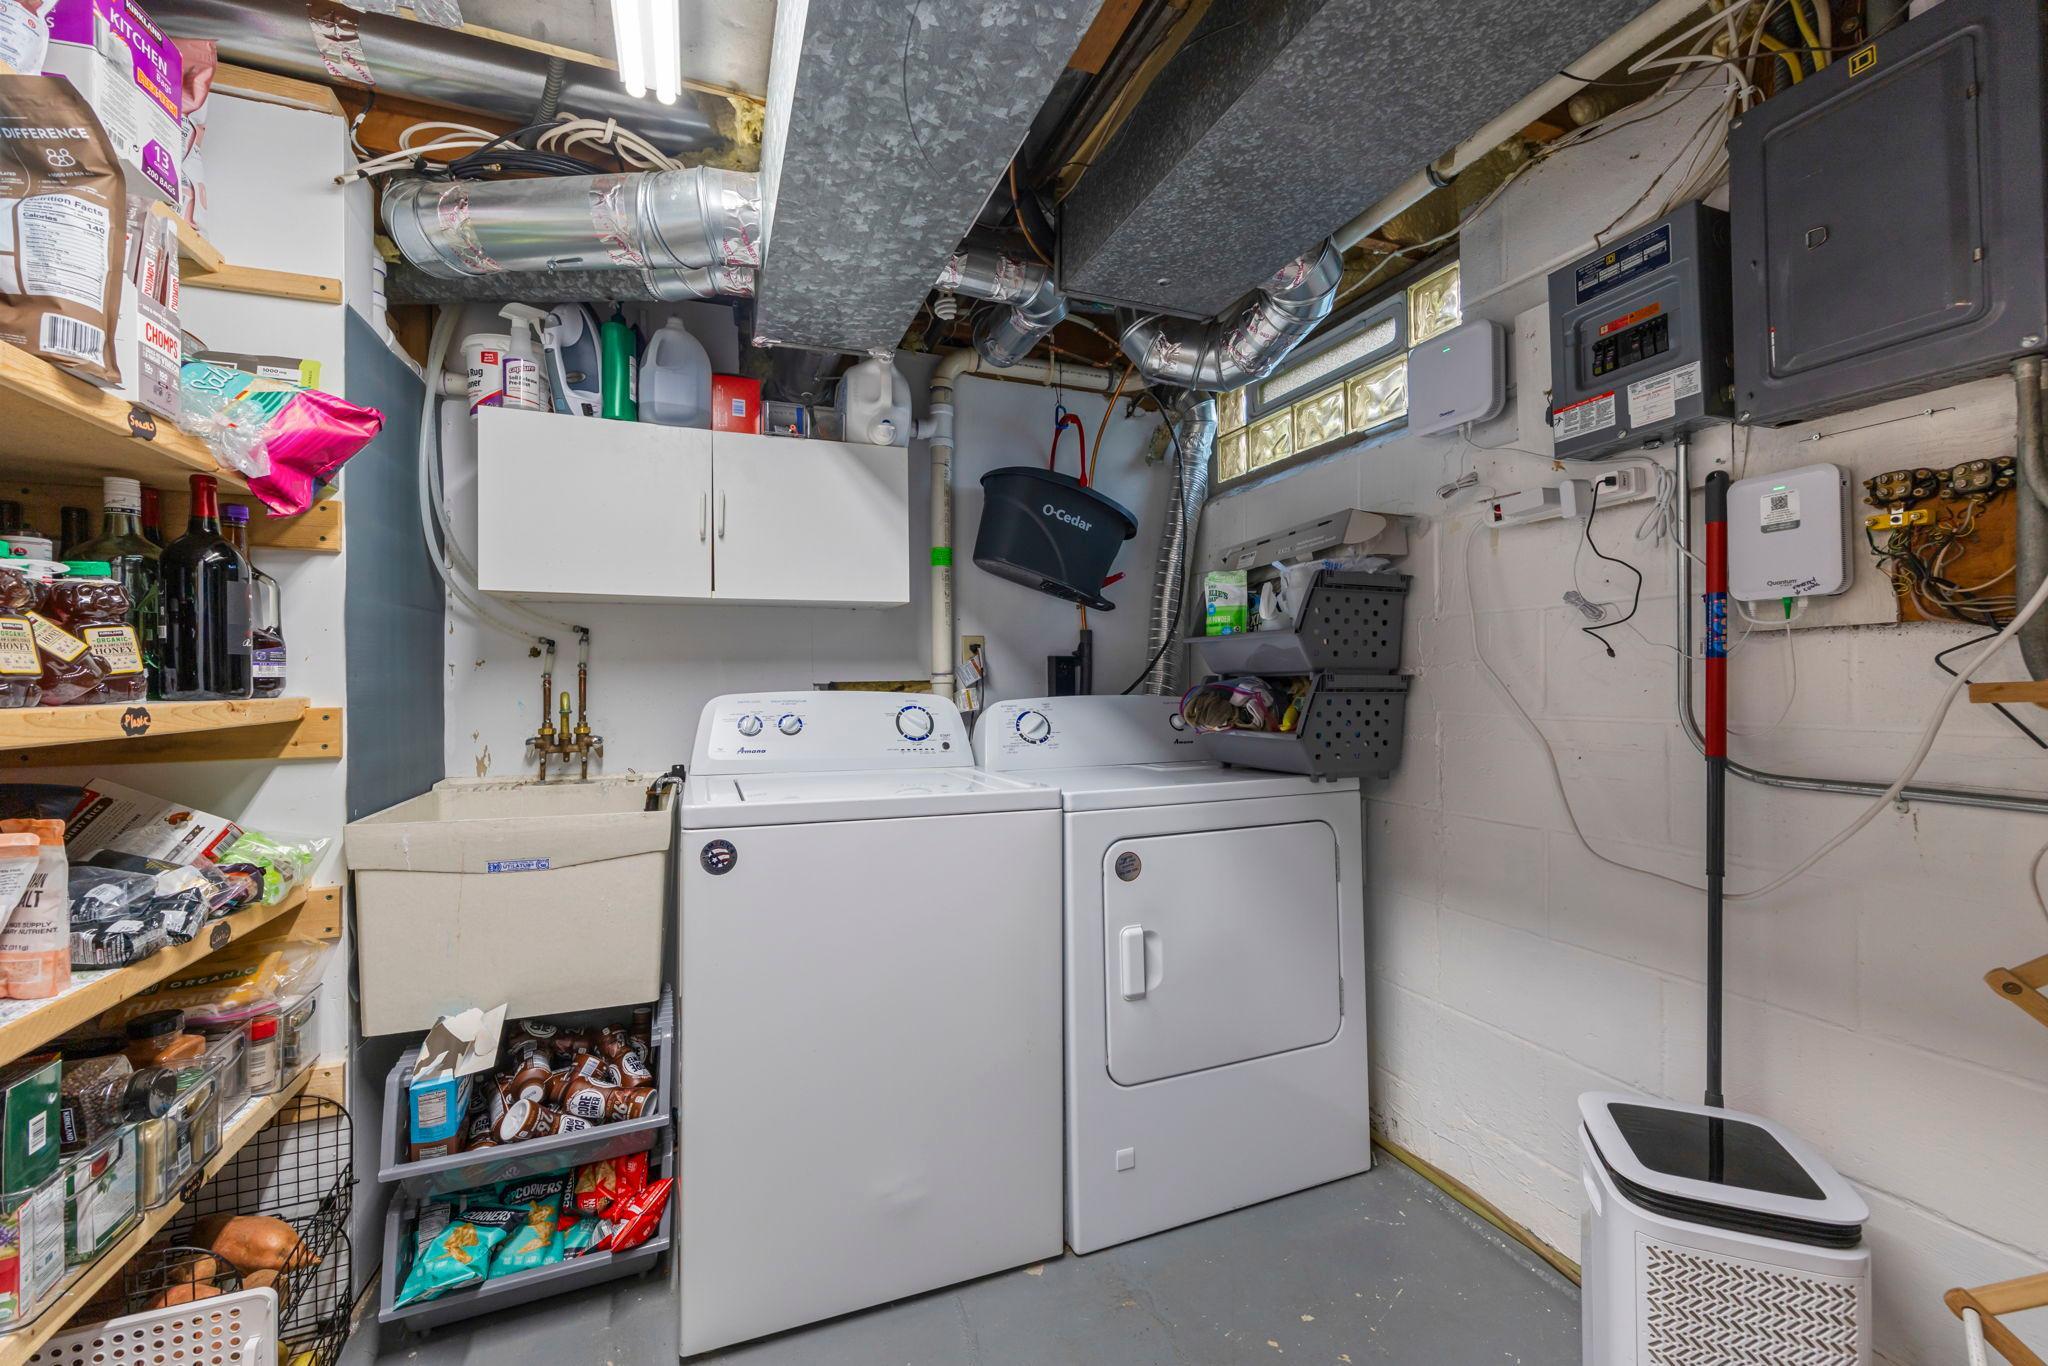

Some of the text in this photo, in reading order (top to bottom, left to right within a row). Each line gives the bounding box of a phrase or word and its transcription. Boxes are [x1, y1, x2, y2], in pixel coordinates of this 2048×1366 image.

[110, 8, 168, 76] KITCHEN
[156, 73, 172, 95] Bags
[1, 127, 90, 140] DIFFERENCE
[154, 146, 170, 171] 13
[146, 166, 176, 196] 200 BAGS
[74, 201, 104, 217] Facts
[23, 212, 105, 235] Calories 140
[145, 322, 178, 360] CHOMPS
[470, 368, 484, 378] Rug
[1042, 503, 1093, 532] O-Cedar
[1766, 579, 1798, 587] Quantum
[0, 641, 31, 651] HONEY
[95, 647, 134, 655] HONEY
[736, 746, 767, 754] Amana
[18, 926, 58, 935] NUTRIENT
[169, 966, 255, 989] ORGANIC
[578, 1095, 593, 1117] CORE
[589, 1096, 602, 1118] POWER
[63, 1110, 75, 1141] KIRKLAND
